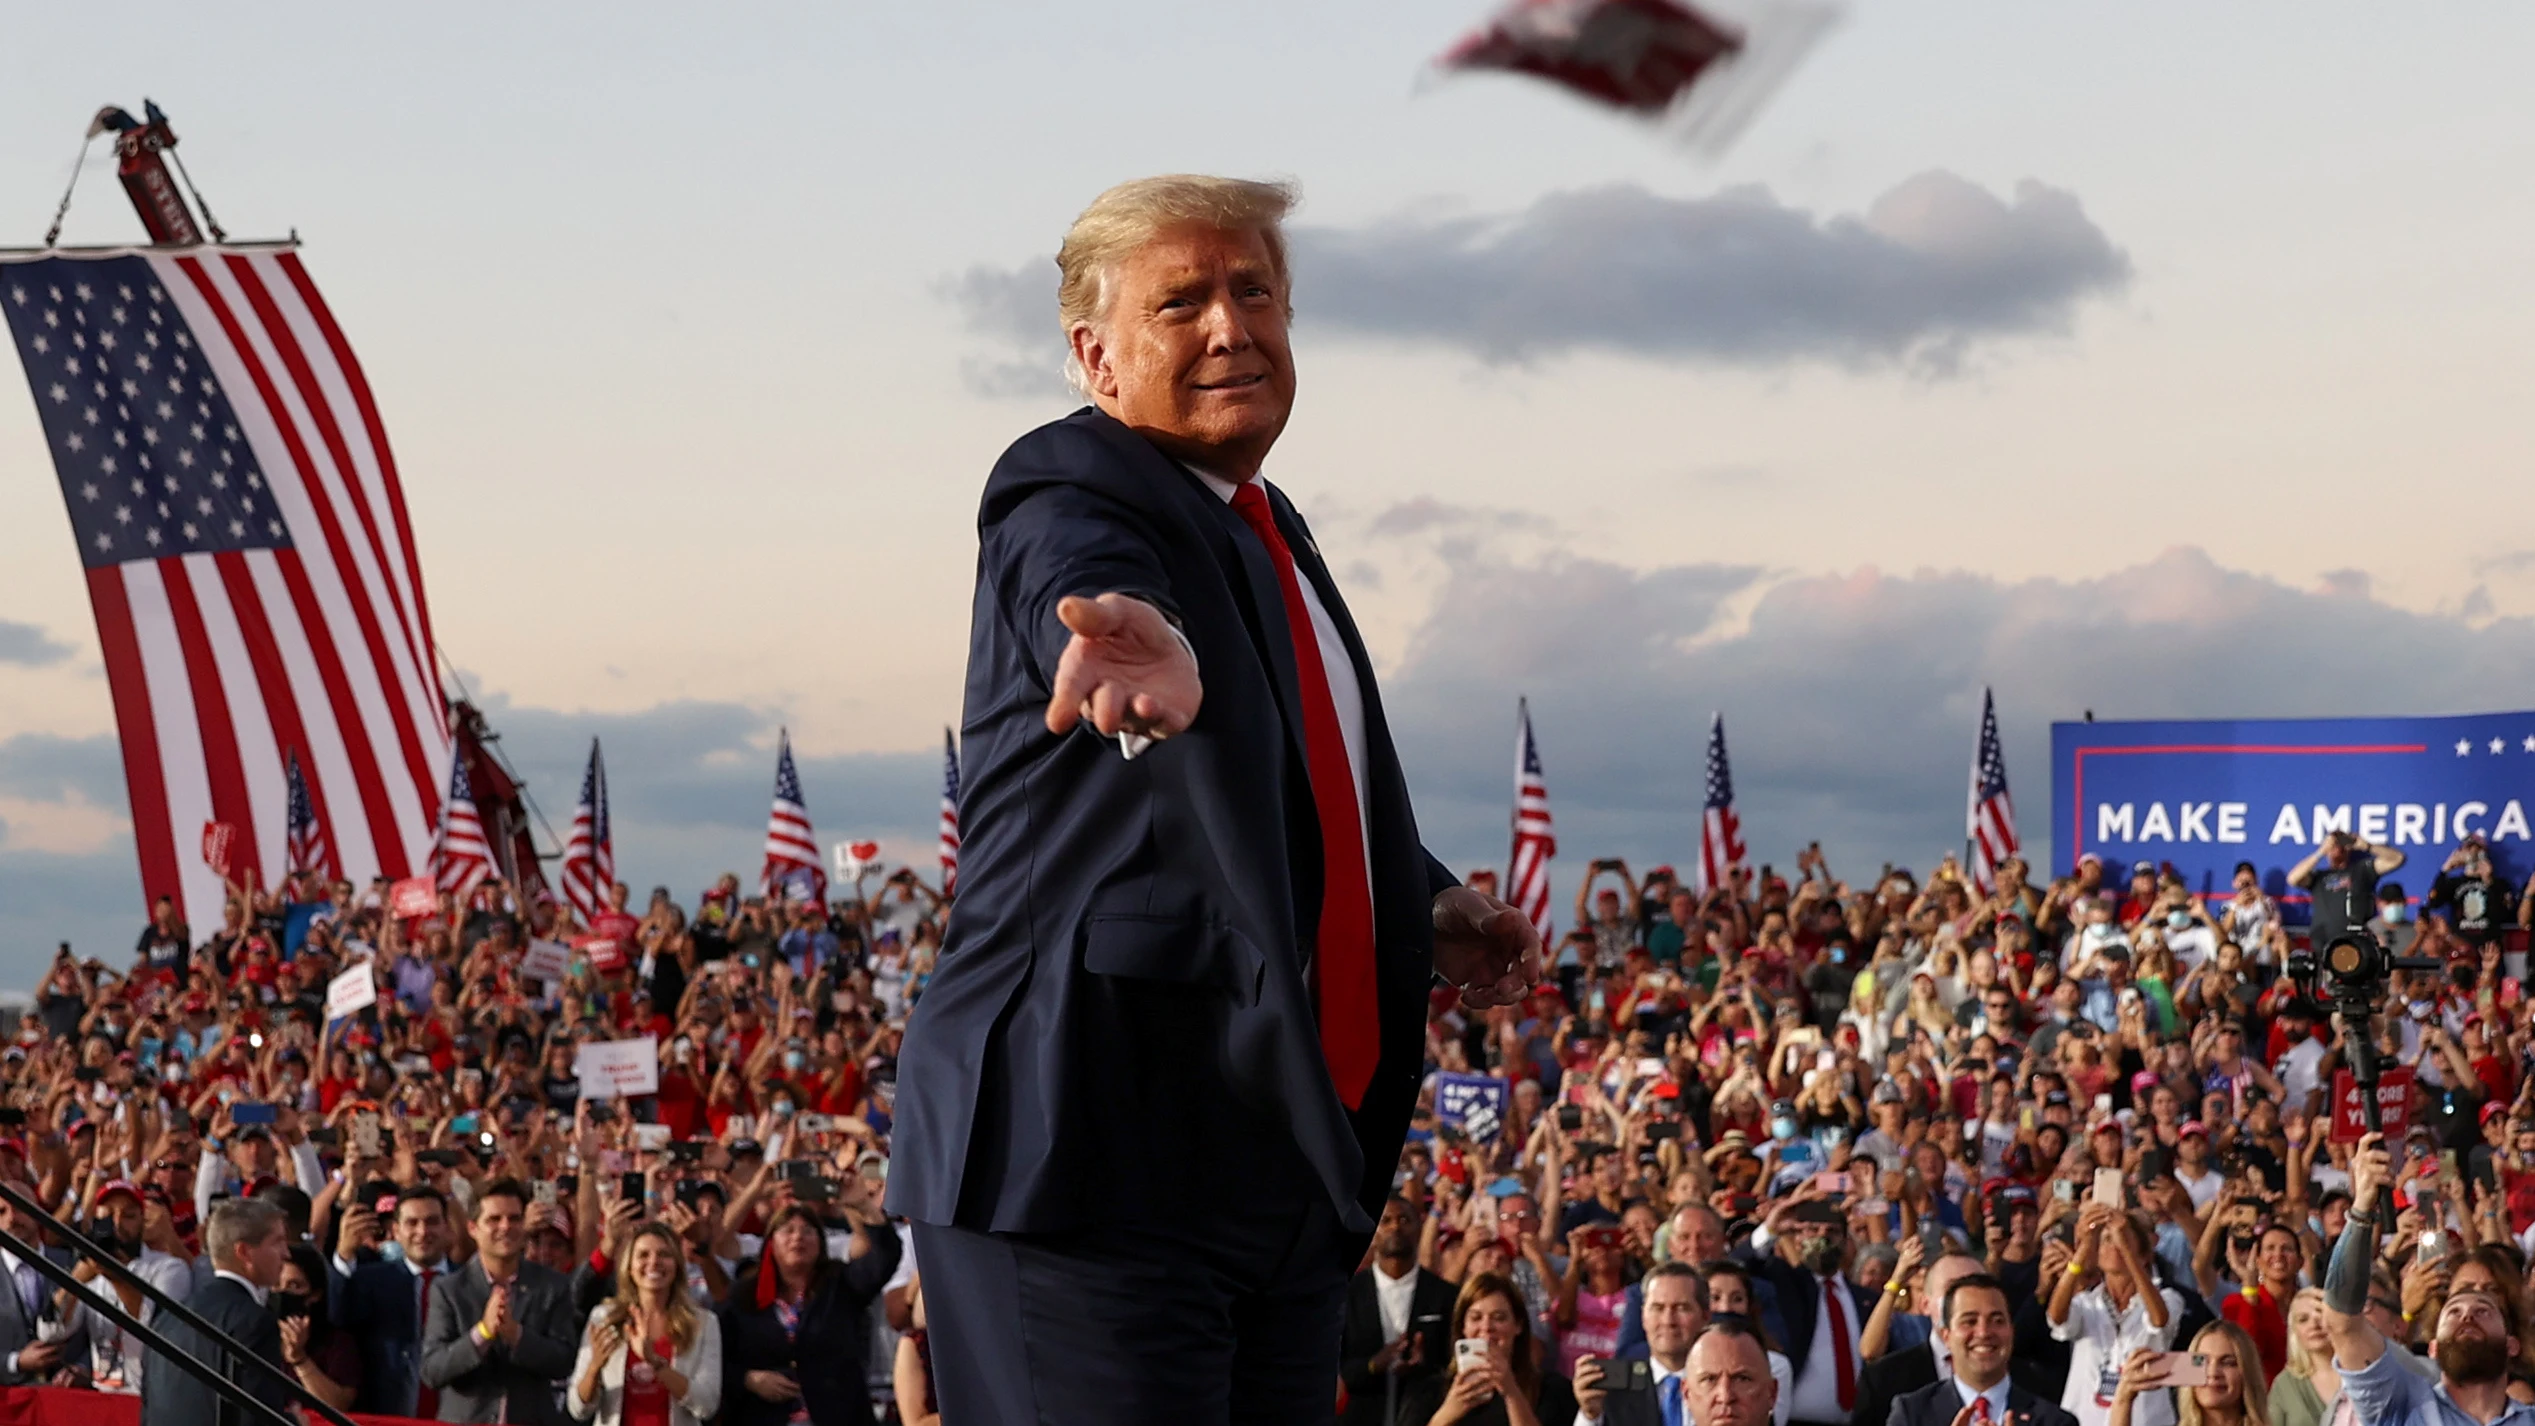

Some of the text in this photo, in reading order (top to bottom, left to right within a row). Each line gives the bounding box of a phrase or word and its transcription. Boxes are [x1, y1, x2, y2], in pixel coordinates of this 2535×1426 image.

[2098, 800, 2532, 845] MAKE AMERICA
[2345, 1084, 2406, 1105] 4 ORE
